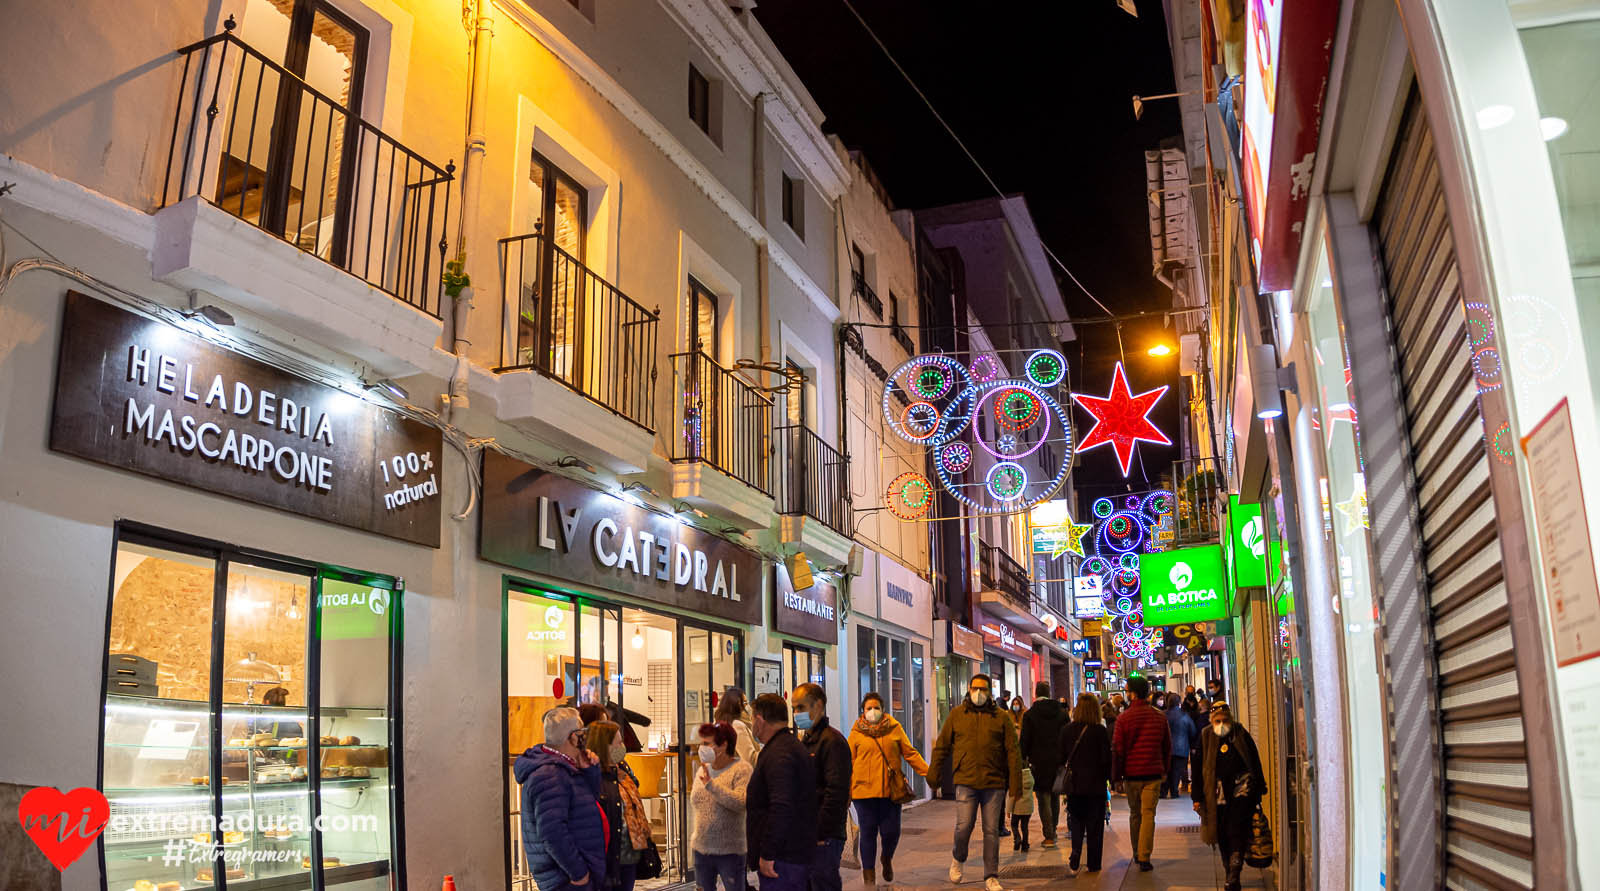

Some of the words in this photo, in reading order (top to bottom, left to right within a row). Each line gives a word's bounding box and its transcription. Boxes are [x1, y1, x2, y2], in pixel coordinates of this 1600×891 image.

[128, 344, 335, 446] HELADERIA
[126, 398, 333, 493] MASCARPONE
[380, 451, 434, 482] 100%
[384, 473, 438, 510] natural
[594, 517, 741, 602] CATEDRAL
[784, 591, 834, 621] RESTAURANTE
[1149, 594, 1166, 607] LA
[1168, 588, 1218, 605] BOTICA
